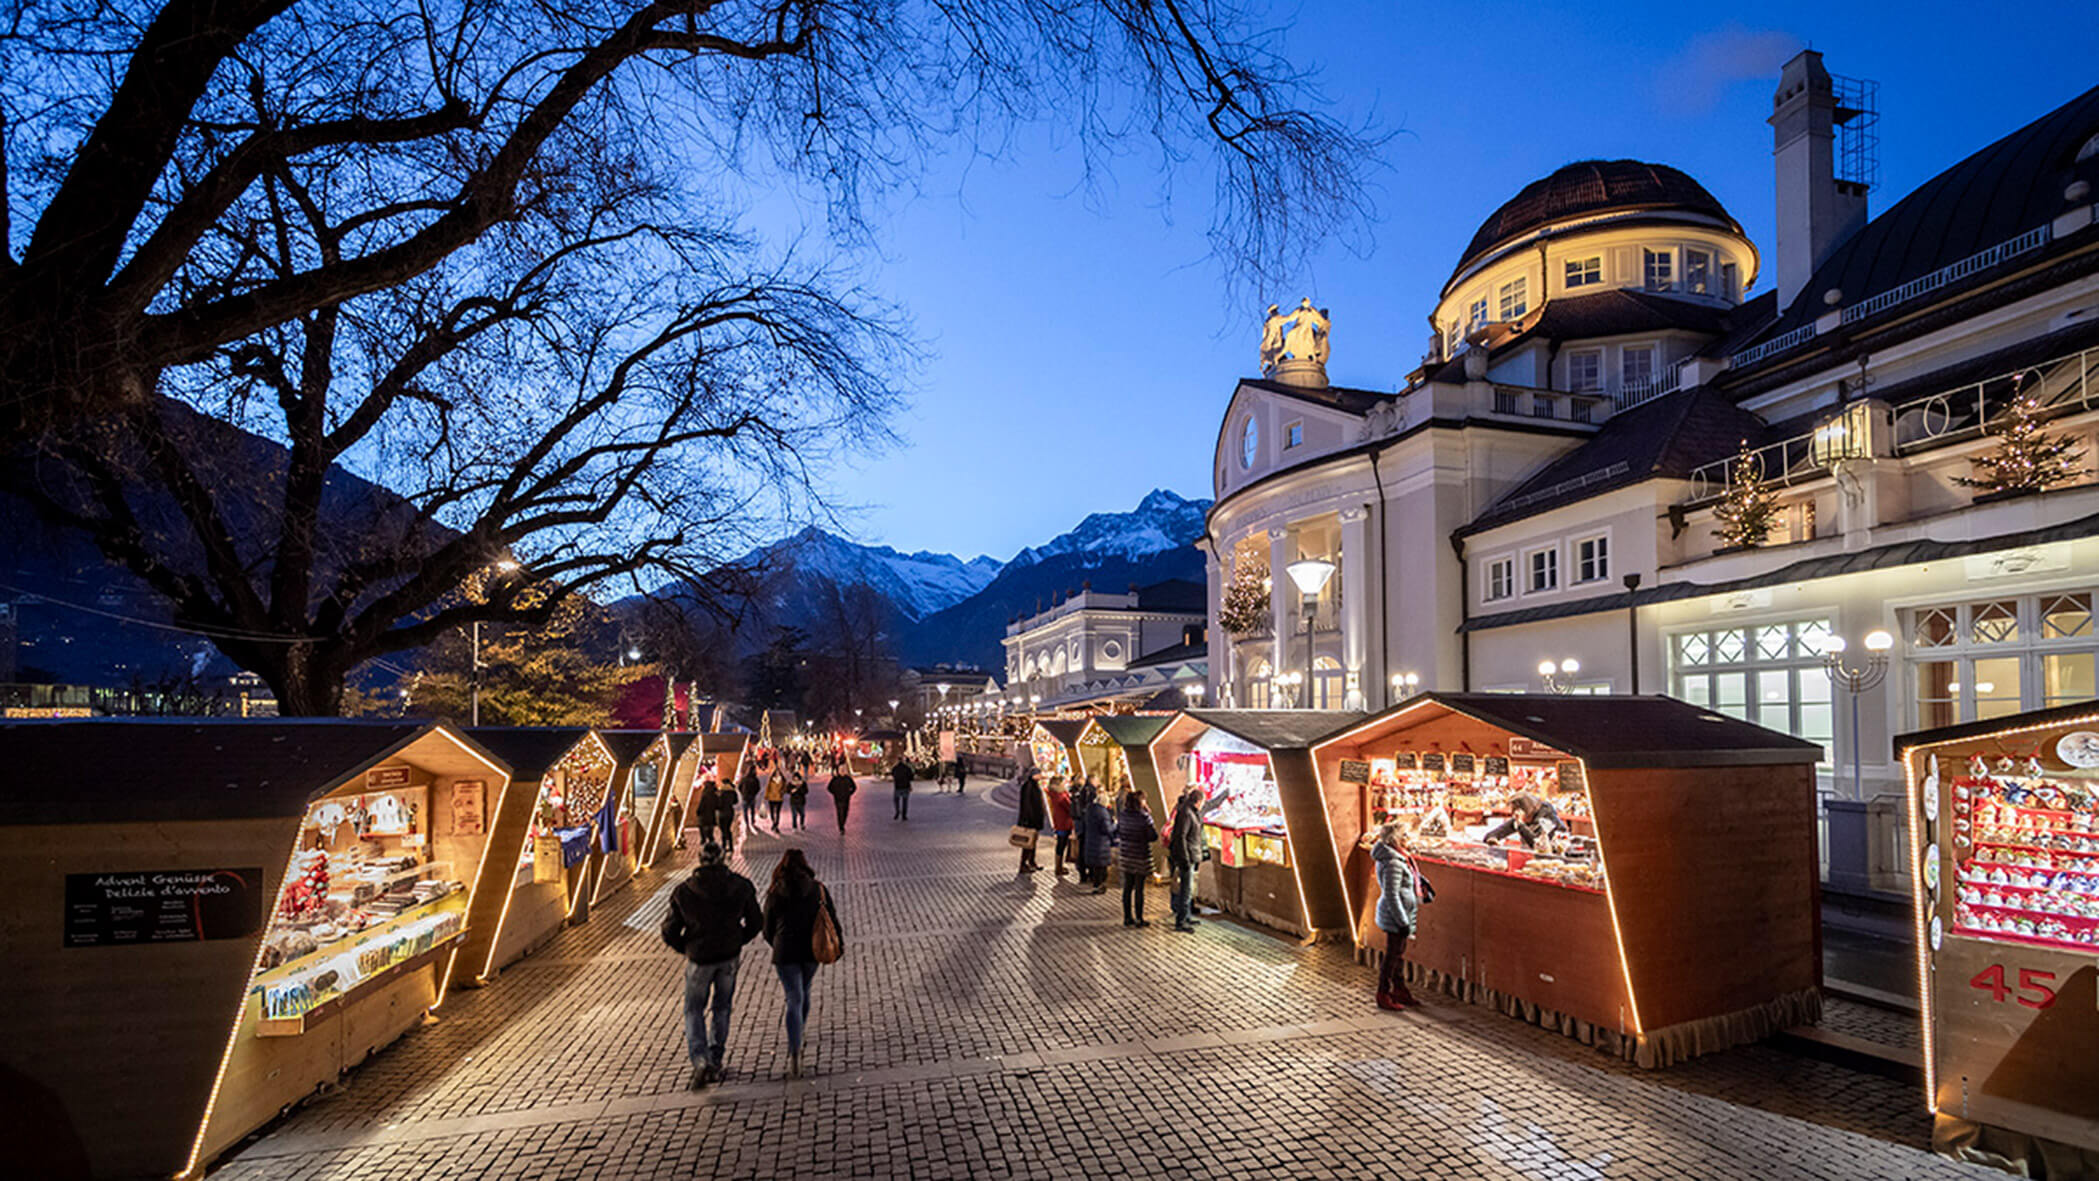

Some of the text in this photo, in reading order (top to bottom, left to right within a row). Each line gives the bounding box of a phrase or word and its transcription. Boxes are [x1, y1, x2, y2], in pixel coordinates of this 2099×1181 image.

[95, 873, 216, 887] Advent Genüsse
[105, 884, 231, 899] Delizie d'avvento
[1969, 964, 2056, 1010] 45
